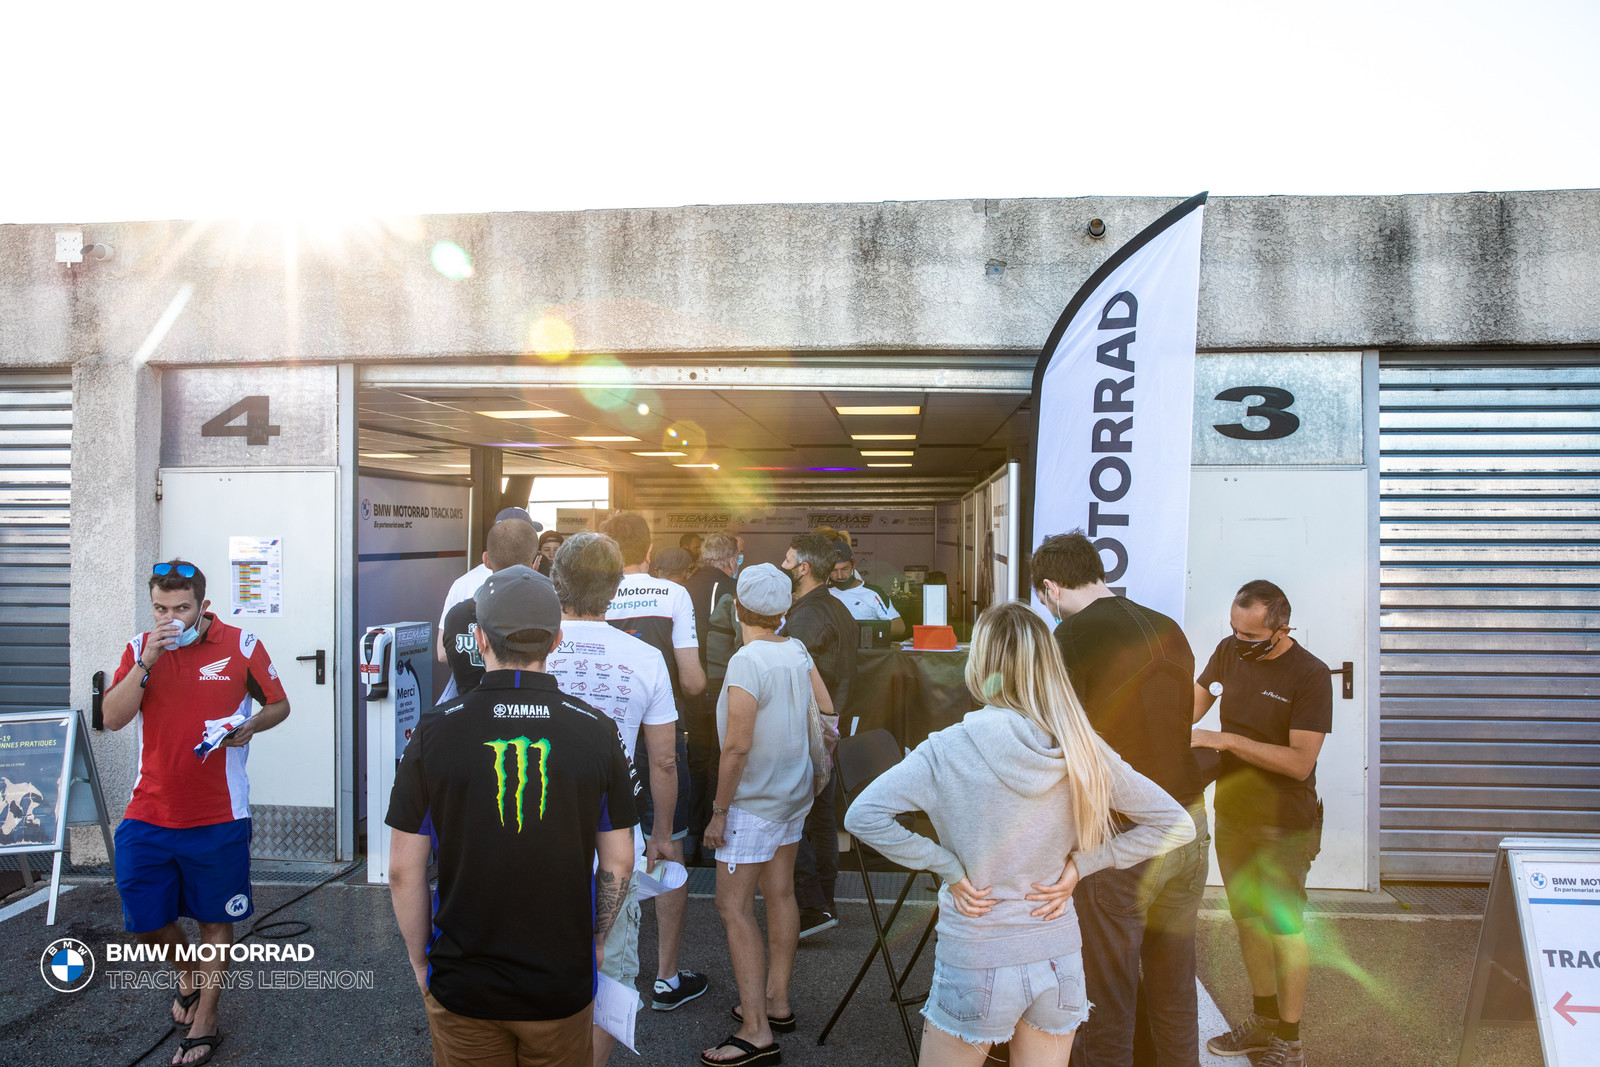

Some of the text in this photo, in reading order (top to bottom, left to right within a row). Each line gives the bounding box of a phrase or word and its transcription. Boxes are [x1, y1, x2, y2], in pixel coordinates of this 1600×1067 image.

[1212, 386, 1300, 440] 3
[201, 395, 280, 445] 4
[1087, 291, 1139, 597] OTORRAD
[374, 503, 463, 519] BMW MOTORRAD TRACK DAYS
[666, 513, 731, 523] TECMAS
[807, 513, 874, 524] TECMAS
[617, 587, 669, 597] Motorrad
[606, 599, 658, 610] otorsport
[397, 626, 430, 641] TECMAS
[397, 685, 415, 700] Merci
[507, 704, 550, 715] YAMAHA
[20, 740, 57, 748] PRATIQUES
